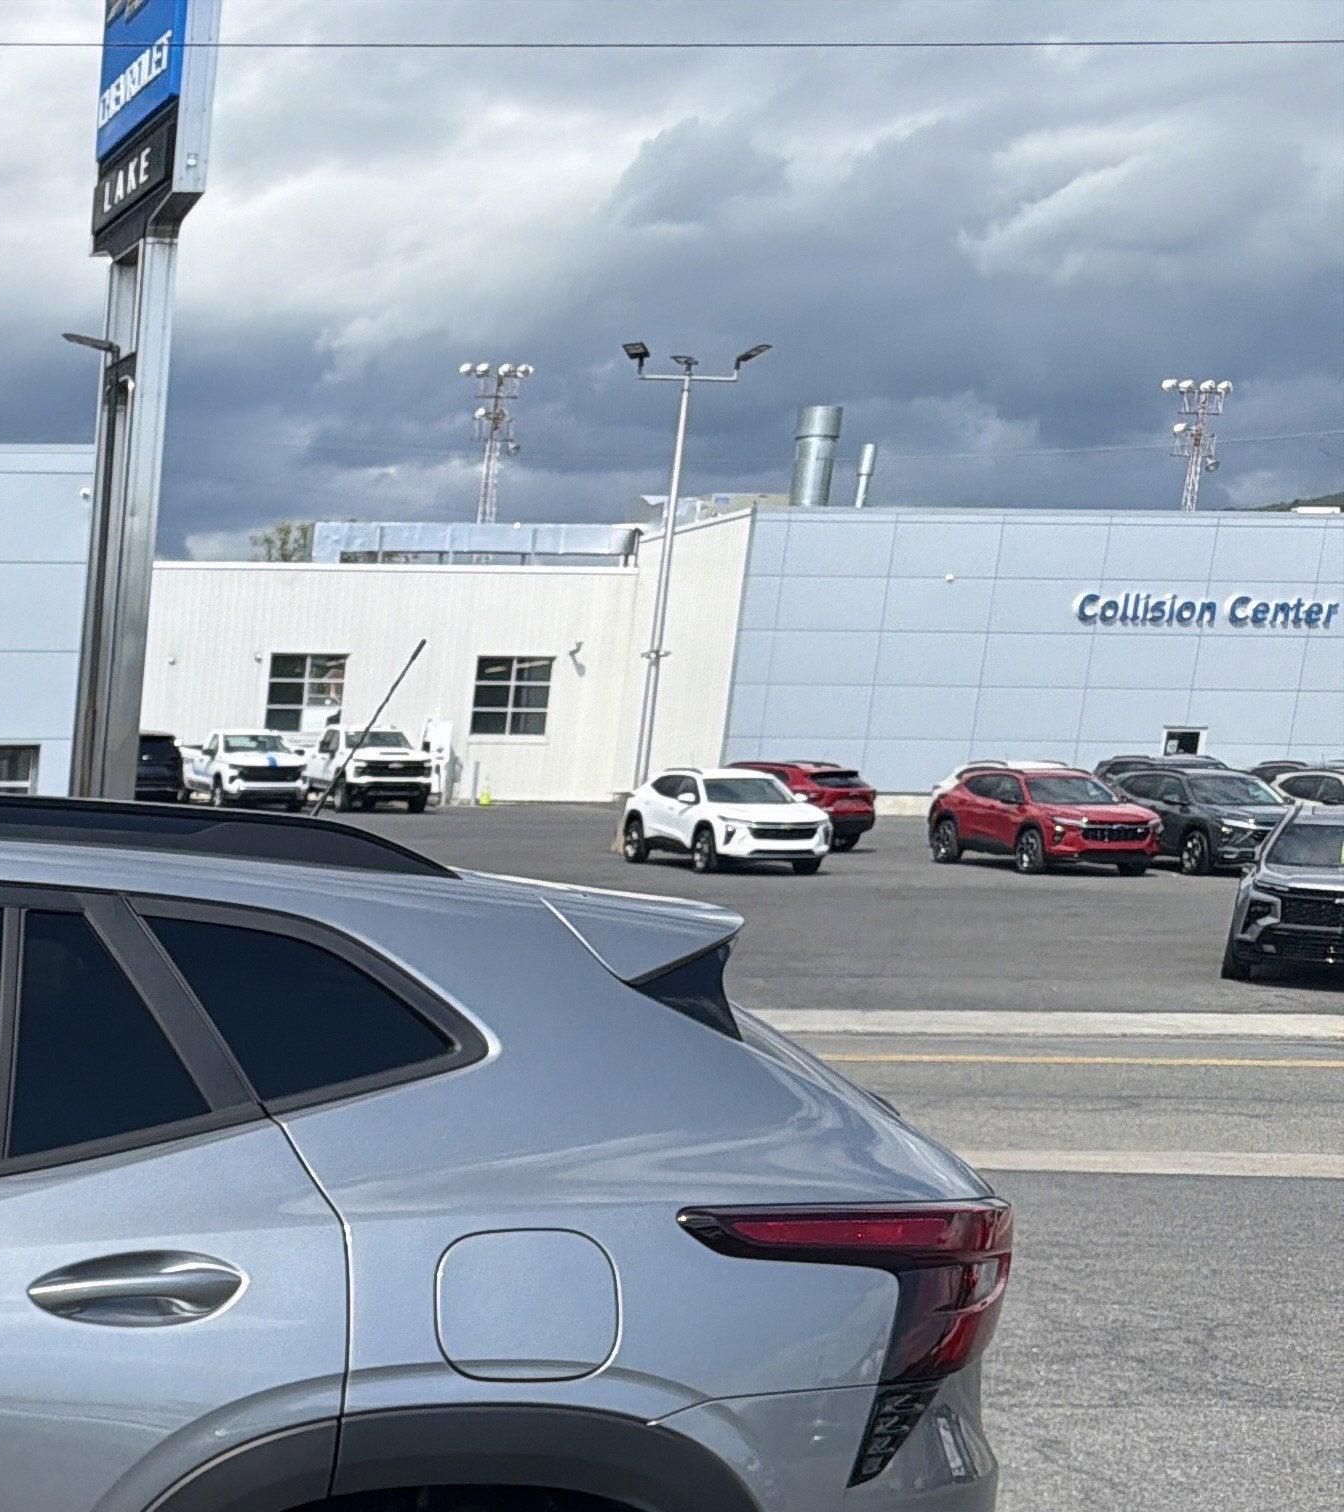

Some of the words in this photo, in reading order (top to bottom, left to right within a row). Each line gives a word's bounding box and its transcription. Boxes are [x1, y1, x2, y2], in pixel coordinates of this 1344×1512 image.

[98, 29, 173, 130] CHEVROLET
[103, 146, 151, 213] LAKE
[1077, 593, 1217, 626] Collision
[1228, 595, 1339, 628] Center
